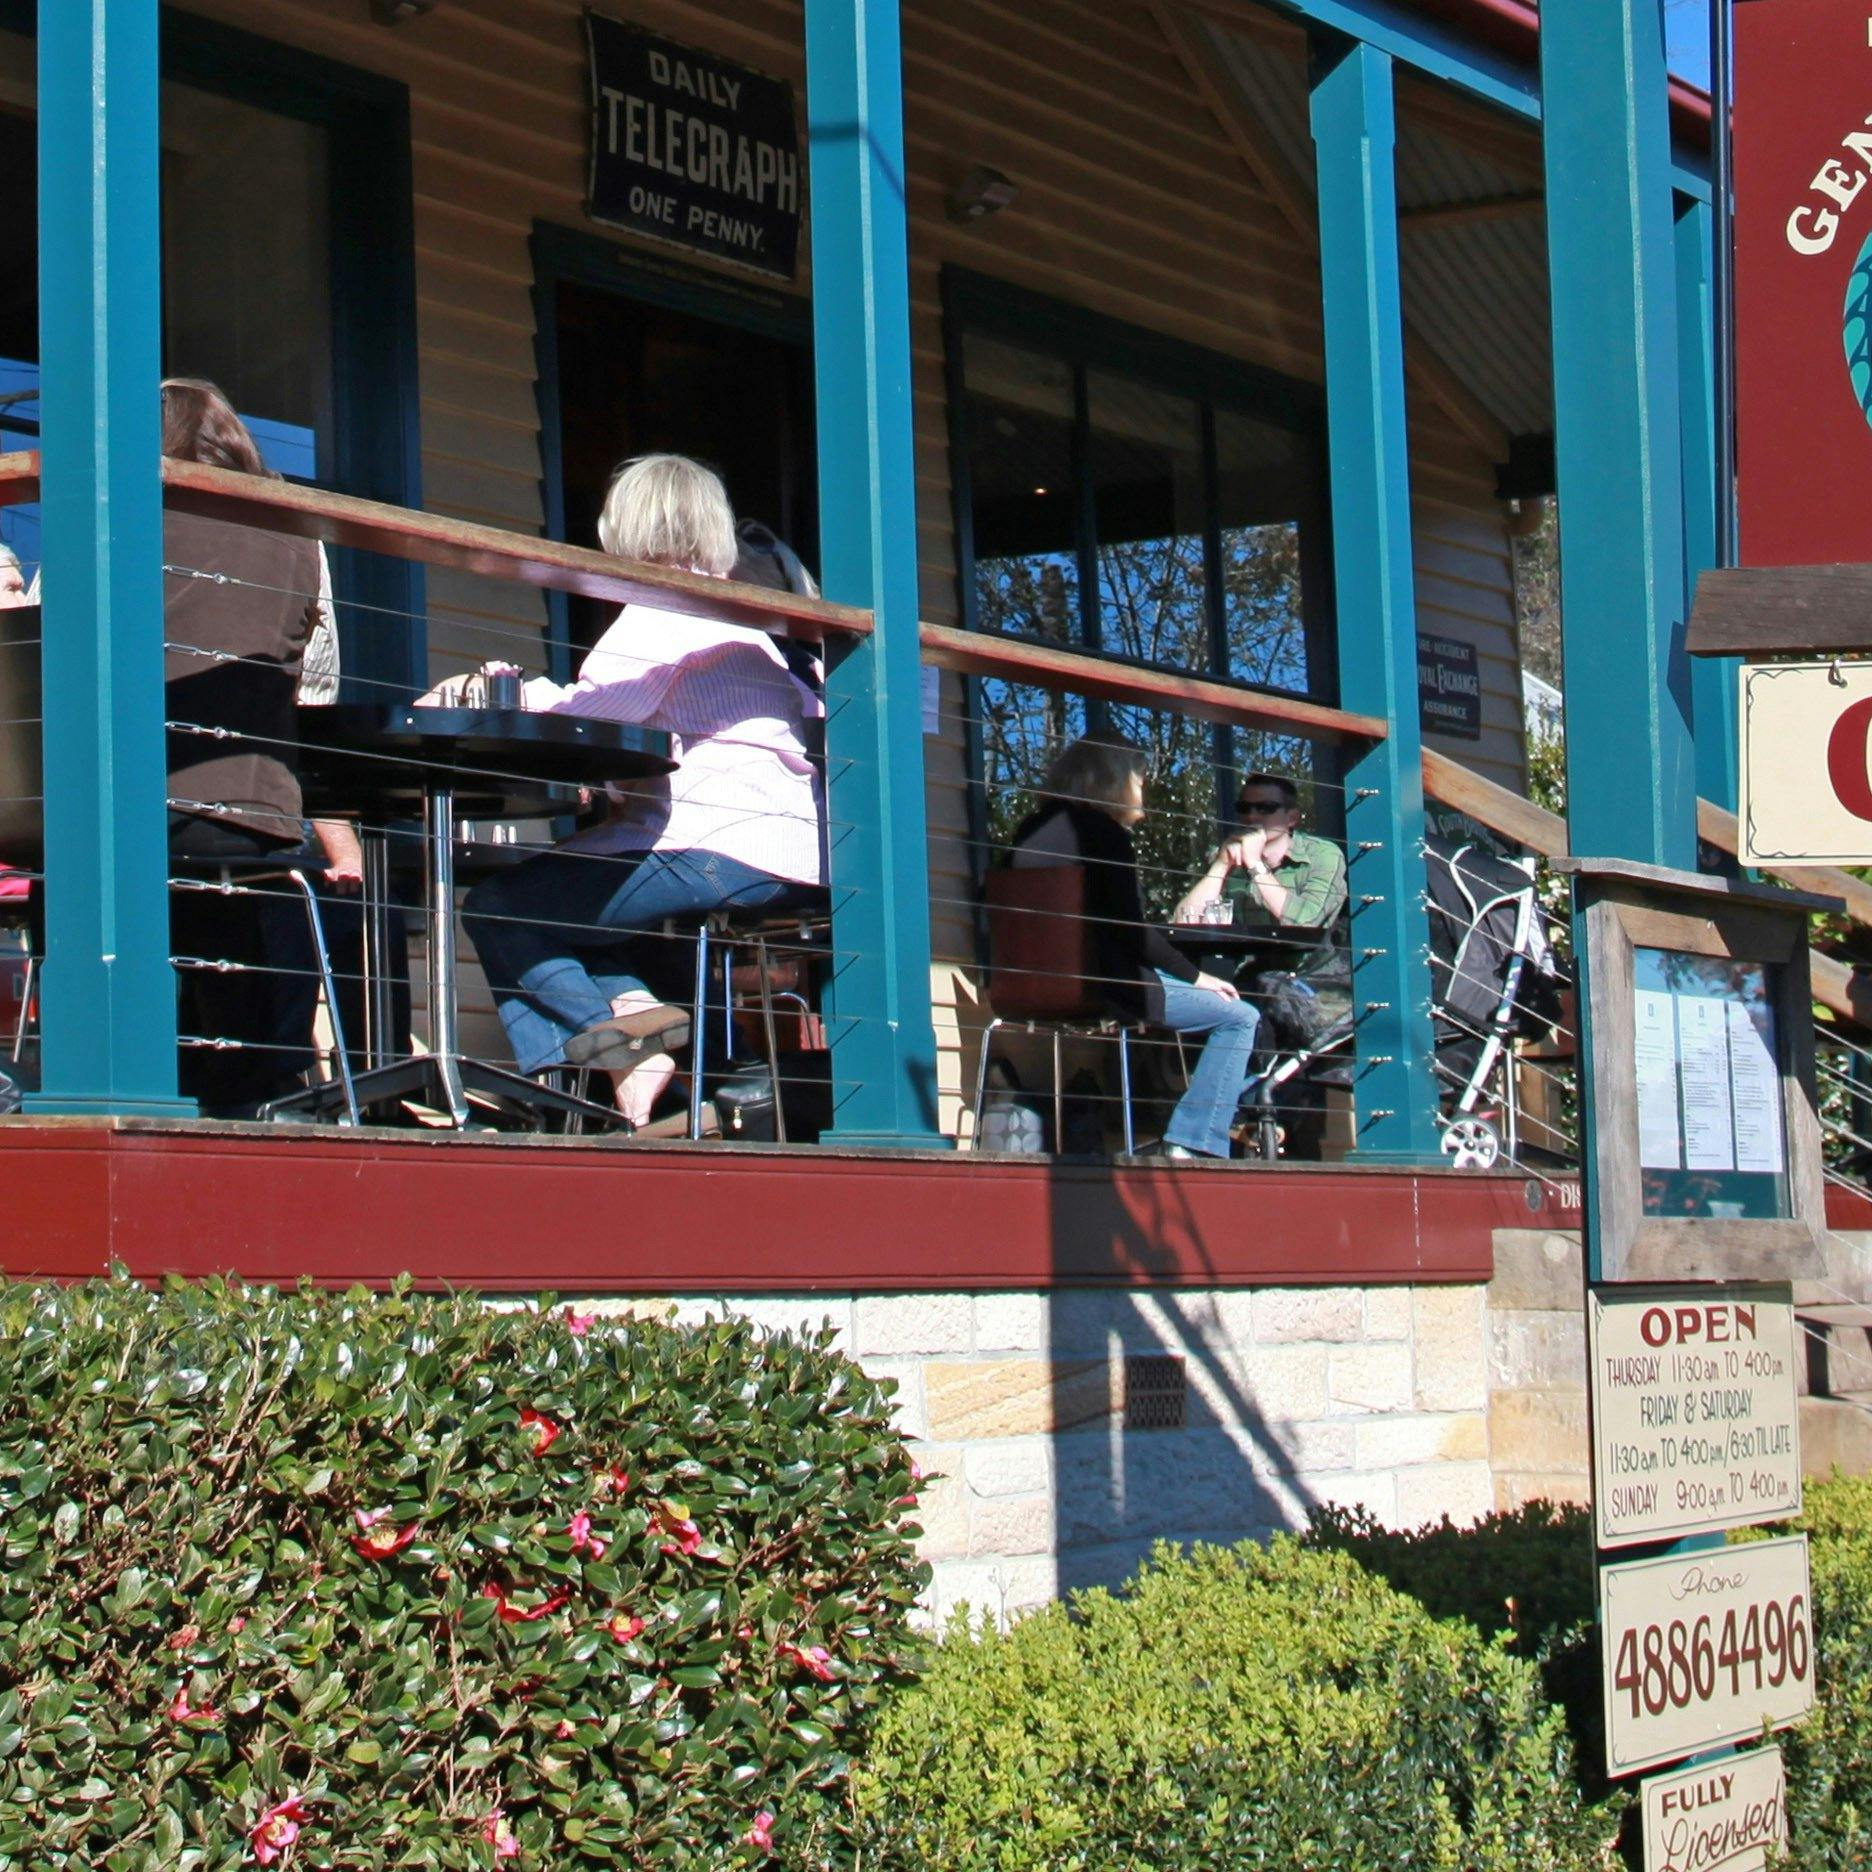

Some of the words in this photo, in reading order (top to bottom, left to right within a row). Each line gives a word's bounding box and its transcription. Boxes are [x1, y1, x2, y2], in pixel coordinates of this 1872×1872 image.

[649, 50, 741, 112] DAILY
[601, 86, 798, 214] TELEGRAPH
[629, 186, 677, 224] ONE
[1640, 1304, 1757, 1348] OPEN
[1606, 1355, 1661, 1388] THURSDAY
[1724, 1351, 1739, 1378] TO
[1640, 1394, 1679, 1428] FRIDAY
[1684, 1390, 1697, 1423] &
[1701, 1388, 1754, 1421] SATURDAY
[1660, 1438, 1677, 1468] TO
[1770, 1424, 1791, 1455] LATE
[1612, 1483, 1659, 1519] SUNDAY
[1729, 1471, 1744, 1504] TO
[1668, 1567, 1750, 1601] Phone
[1661, 1773, 1735, 1818] FULLY
[1658, 1778, 1781, 1872] Licensed
